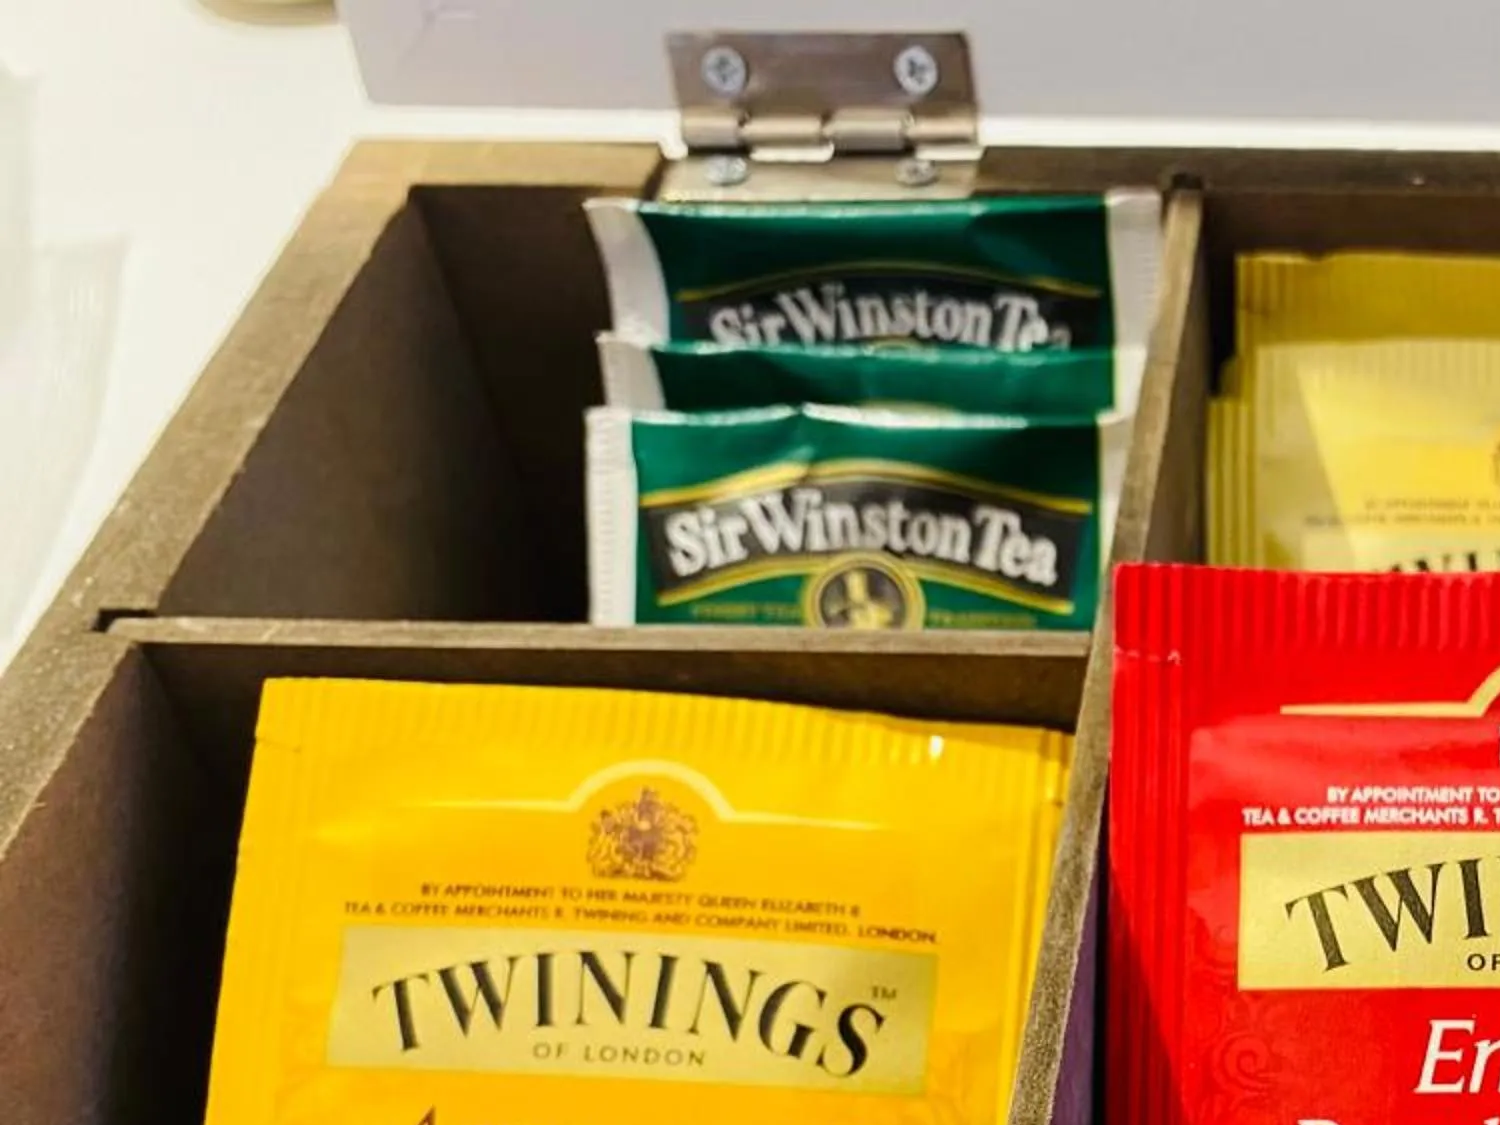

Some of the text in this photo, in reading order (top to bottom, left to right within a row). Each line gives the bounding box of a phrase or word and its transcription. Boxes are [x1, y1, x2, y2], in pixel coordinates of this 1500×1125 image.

[665, 487, 1058, 586] Sir Winston Tea
[1327, 787, 1348, 803] BY
[1351, 787, 1472, 803] APPOINTMENT
[1478, 787, 1500, 803] TO
[1242, 808, 1273, 826] TEA
[1295, 808, 1361, 825] COFFEE
[1363, 808, 1468, 825] MERCHANTS
[372, 949, 886, 1077] TWININGS
[533, 1042, 706, 1067] OF LONDON
